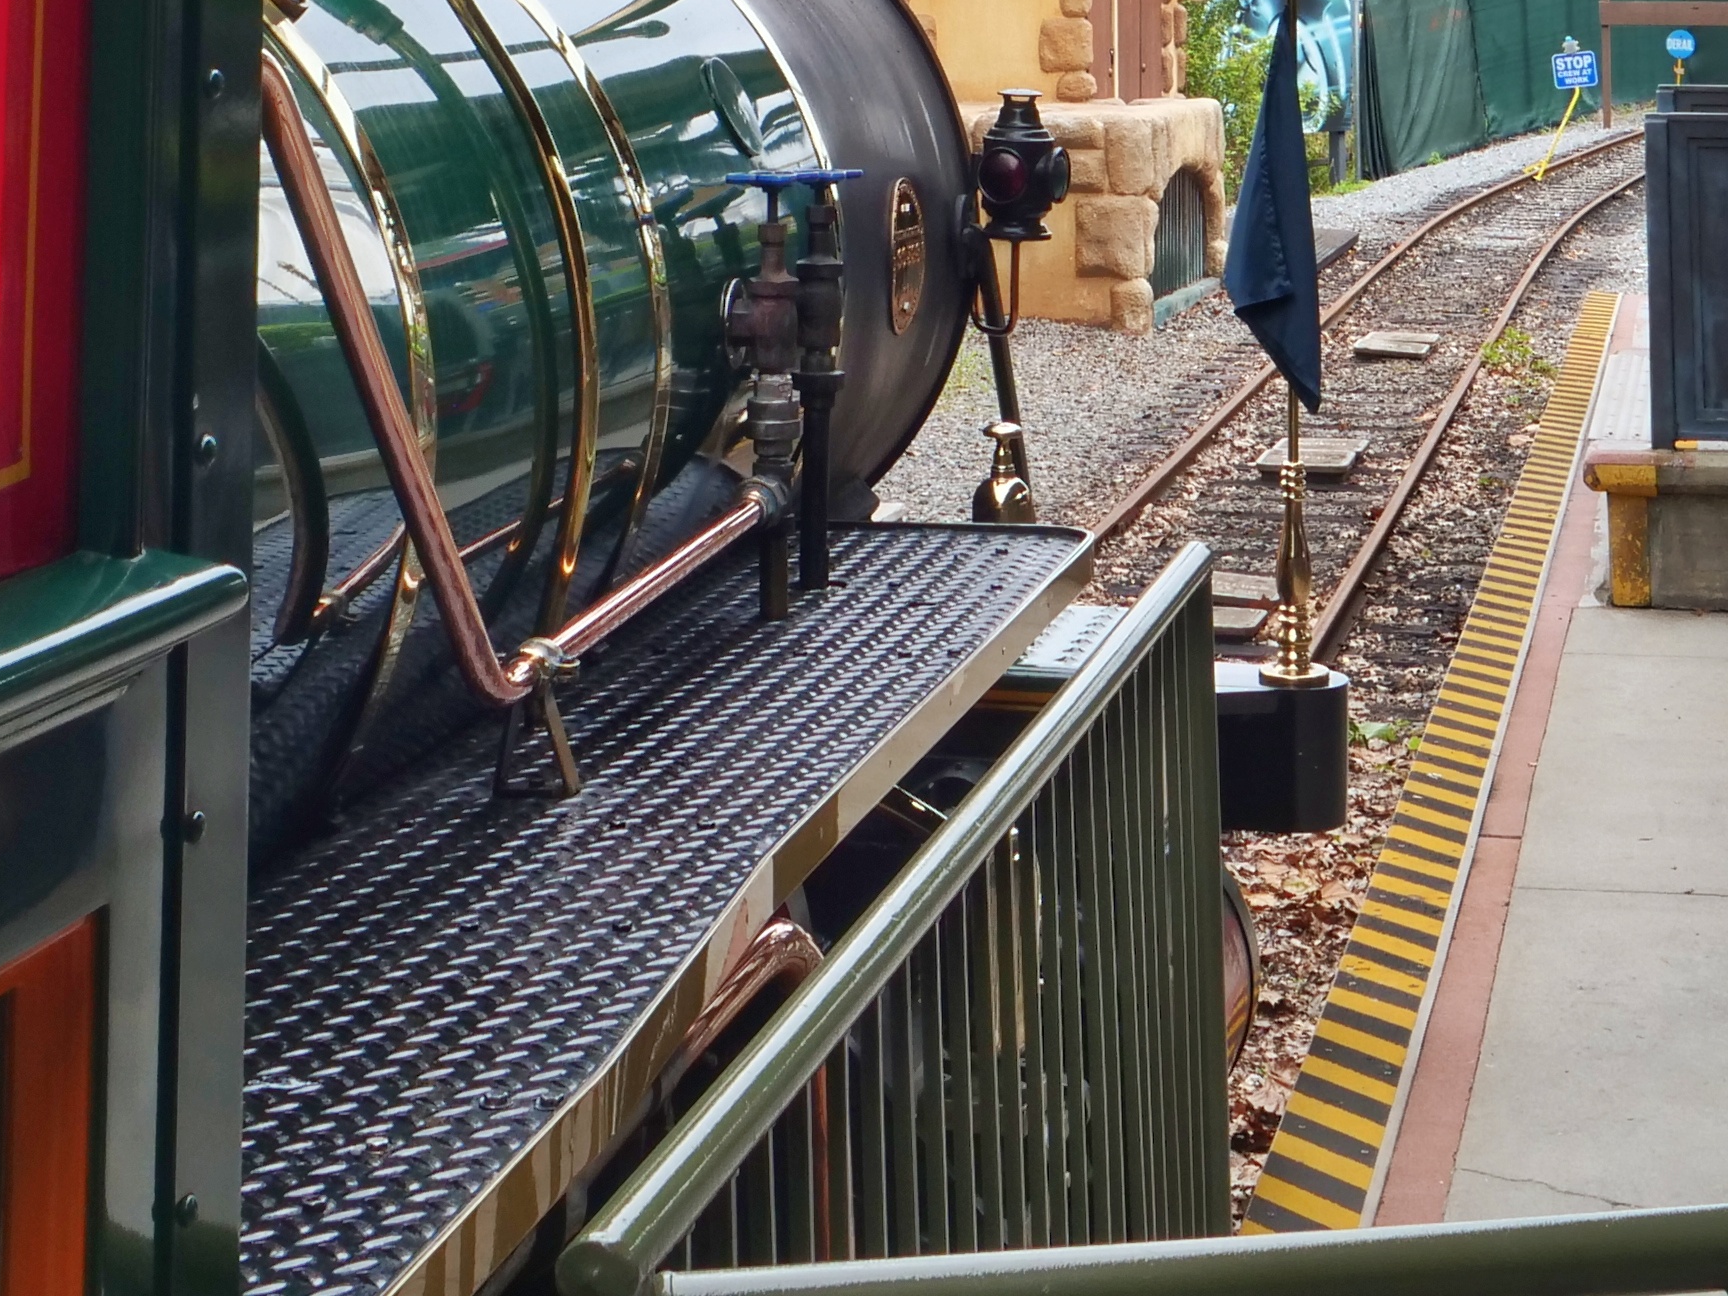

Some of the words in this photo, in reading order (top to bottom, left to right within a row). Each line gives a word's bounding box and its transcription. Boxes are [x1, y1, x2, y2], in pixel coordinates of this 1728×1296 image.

[1666, 38, 1694, 52] DERAIL
[1556, 55, 1592, 70] STOP
[1557, 70, 1580, 78] CREW
[1582, 68, 1592, 76] AT
[1564, 76, 1589, 85] WORK
